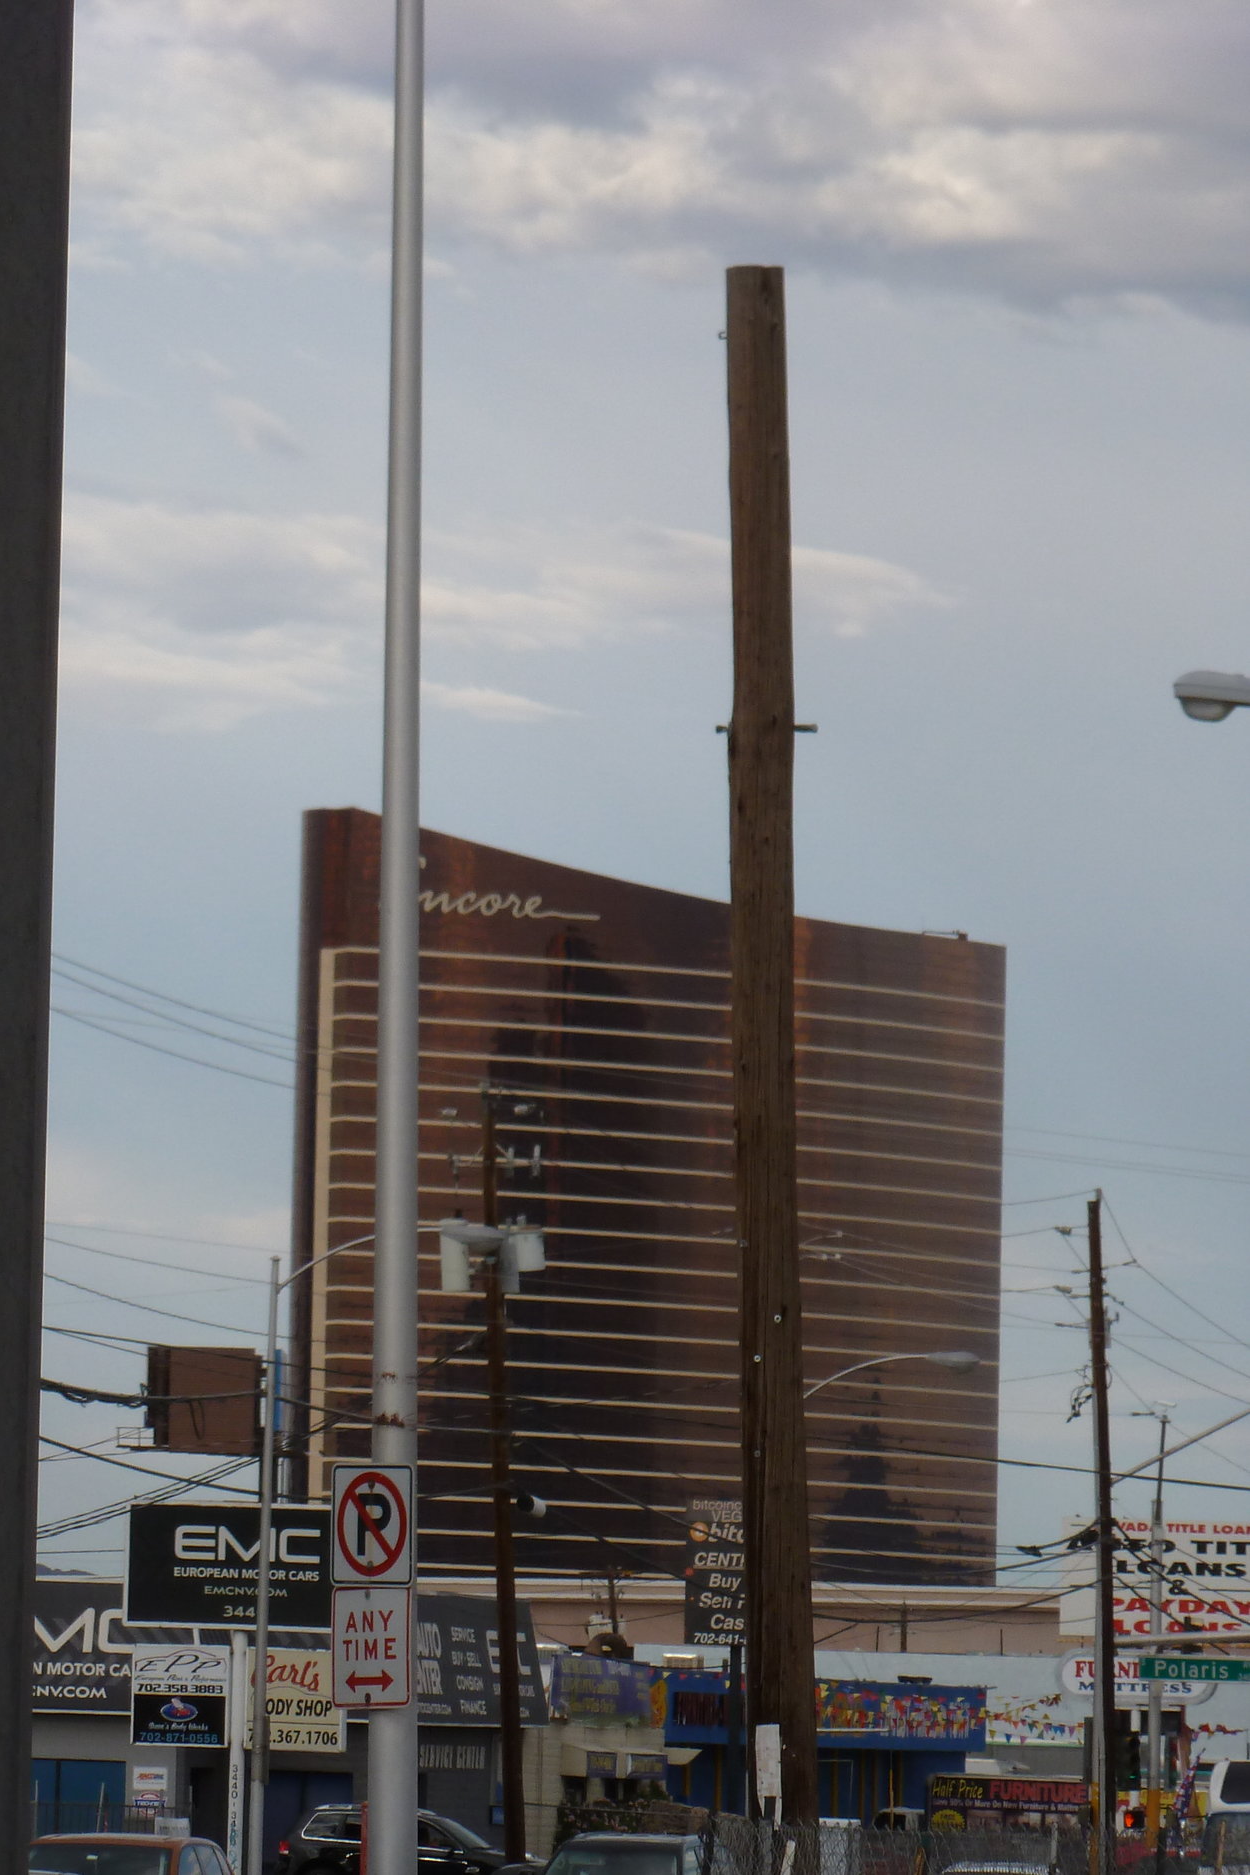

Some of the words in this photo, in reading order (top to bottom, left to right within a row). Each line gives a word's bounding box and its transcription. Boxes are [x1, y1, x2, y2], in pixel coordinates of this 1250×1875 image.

[1166, 1523, 1206, 1533] TITLE
[174, 1525, 321, 1564] EMC
[173, 1566, 239, 1579] EUROPEAN
[241, 1568, 286, 1581] MOOR
[288, 1570, 320, 1582] CARS
[1116, 1560, 1247, 1577] LOANS
[709, 1573, 741, 1592] Buy
[345, 1610, 394, 1633] ANY
[710, 1613, 745, 1631] Cas
[451, 1626, 476, 1643] SERVICE
[693, 1632, 747, 1646] 702-641-
[343, 1638, 397, 1662] TIME
[451, 1650, 463, 1666] BUY
[466, 1651, 482, 1667] SELL
[486, 1629, 531, 1676] EC
[46, 1662, 107, 1677] MOTOR
[139, 1654, 222, 1673] EPP
[1075, 1660, 1140, 1679] FUNI
[1153, 1660, 1229, 1680] Polaris
[33, 1685, 108, 1699] NV.COM
[1079, 1681, 1193, 1694] MTTRSS
[295, 1699, 332, 1717] SHOP
[460, 1699, 487, 1716] FINANCE
[139, 1732, 218, 1744] 702-871-0556
[248, 1728, 338, 1746] 7.367.1706
[932, 1779, 956, 1798] Half
[957, 1780, 984, 1799] Price
[989, 1780, 1088, 1804] FURNITURE
[974, 1800, 991, 1808] More
[1019, 1802, 1049, 1811] Furniture
